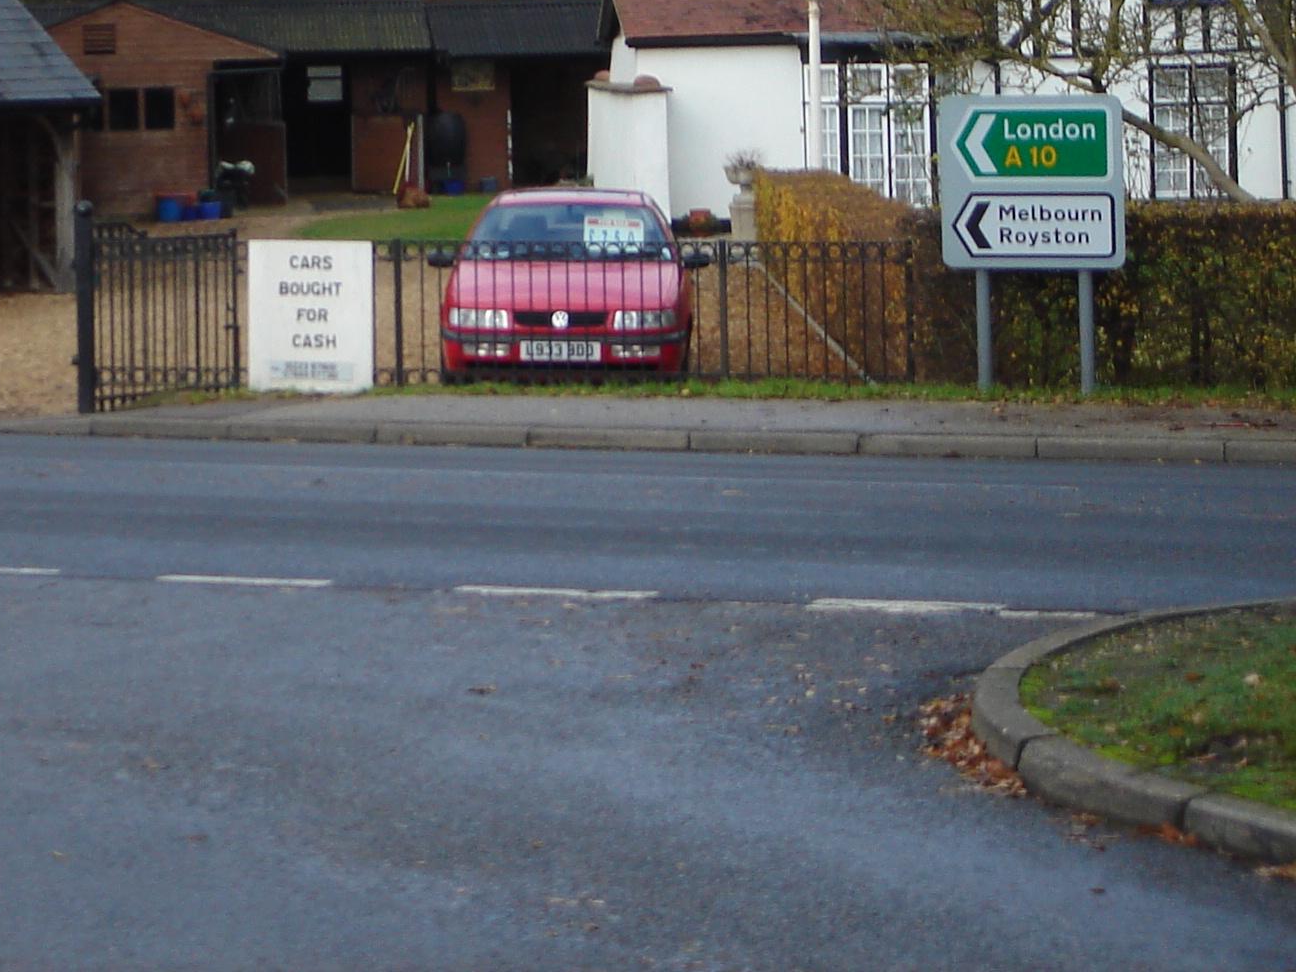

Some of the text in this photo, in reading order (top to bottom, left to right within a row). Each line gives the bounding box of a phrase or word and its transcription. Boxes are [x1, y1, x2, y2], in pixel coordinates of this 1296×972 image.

[1003, 118, 1097, 140] London
[999, 204, 1102, 222] Melbourn
[999, 227, 1090, 246] Royston
[289, 255, 333, 270] CARS
[278, 281, 342, 296] BOUGHT
[296, 308, 328, 322] FOR
[292, 334, 337, 349] CASH
